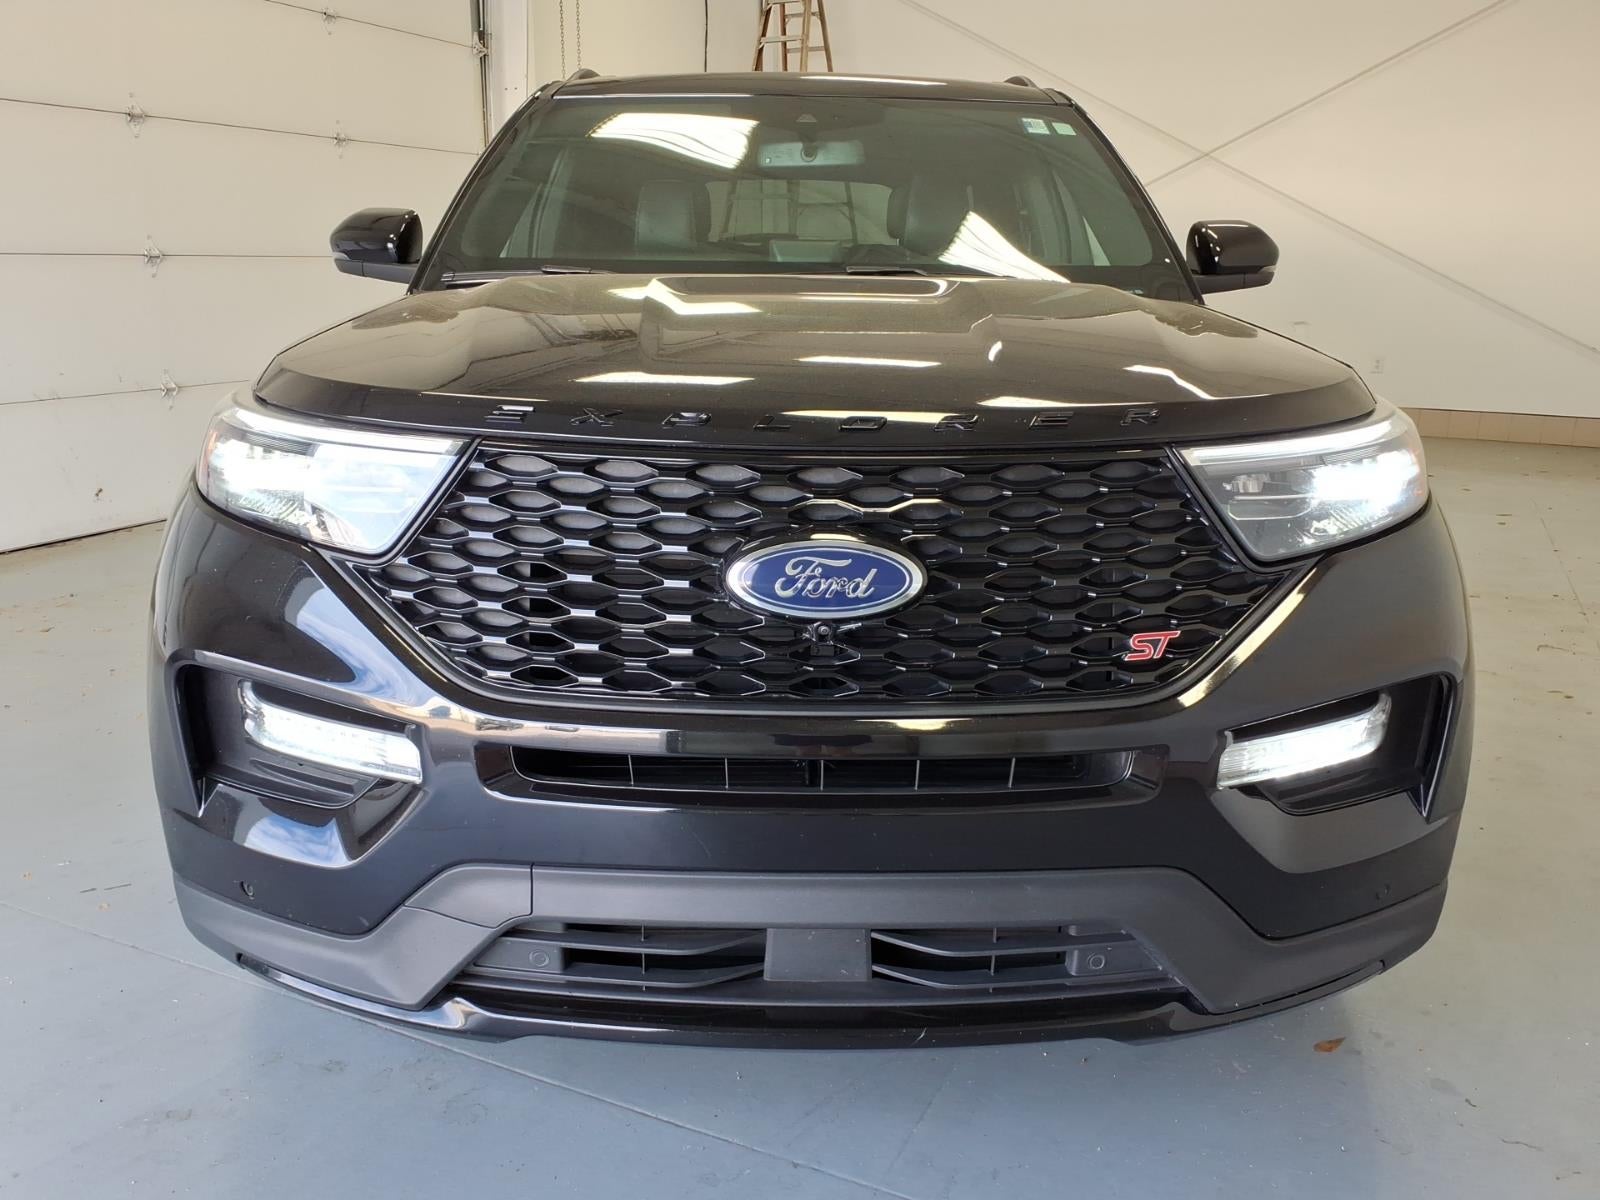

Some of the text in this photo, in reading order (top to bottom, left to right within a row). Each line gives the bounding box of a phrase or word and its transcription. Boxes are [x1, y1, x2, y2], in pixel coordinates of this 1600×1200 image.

[484, 404, 1161, 432] EXPLORER
[774, 556, 878, 598] Ford
[1124, 630, 1181, 661] ST
